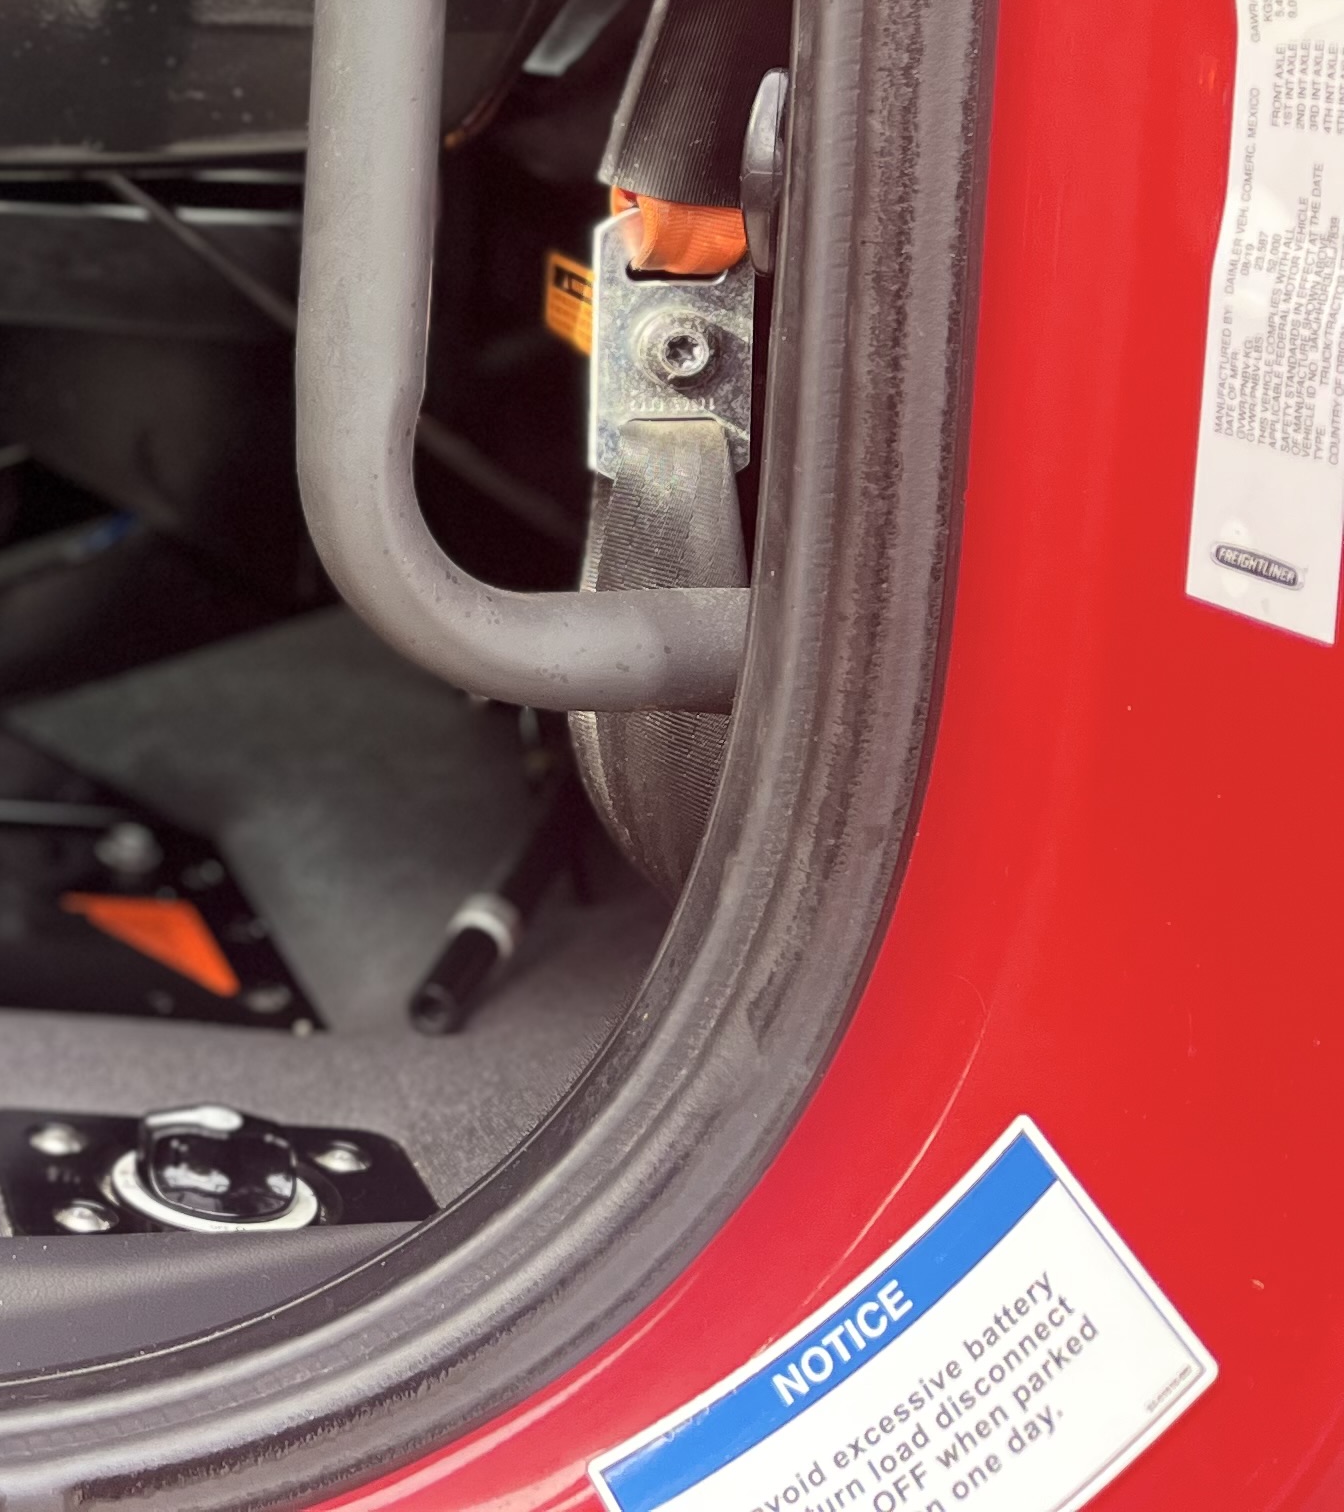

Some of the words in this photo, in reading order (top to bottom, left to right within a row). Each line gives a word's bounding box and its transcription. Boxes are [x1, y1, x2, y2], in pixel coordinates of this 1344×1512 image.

[1271, 83, 1283, 126] FRONT
[1284, 79, 1294, 100] INT
[1295, 79, 1307, 100] INT
[1311, 78, 1321, 101] INT
[1324, 82, 1335, 104] INT
[1283, 103, 1293, 126] 1ST
[1296, 103, 1307, 130] 2ND
[1309, 105, 1320, 131] 3RD
[1323, 106, 1333, 134] 4TH
[1310, 163, 1324, 198] DATE
[1291, 196, 1309, 251] VEHICLE
[1309, 202, 1322, 226] THE
[1283, 226, 1295, 248] ALL
[1308, 230, 1318, 246] AT
[1310, 233, 1329, 278] ABOVE
[1214, 328, 1232, 434] MANUFACTURED
[1224, 238, 1245, 294] DAIMLER
[1247, 87, 1260, 138] MEXICO
[1275, 252, 1290, 285] WITH
[1283, 256, 1301, 304] MOTOR
[1295, 249, 1317, 298] EFFECT
[1266, 287, 1283, 355] COMPLIES
[1293, 302, 1304, 315] IN
[1301, 281, 1322, 330] SHOWN
[1275, 308, 1291, 366] FEDERAL
[1284, 319, 1302, 398] STANDARDS
[1227, 383, 1238, 400] OF
[1260, 359, 1275, 412] VEHICLE
[1293, 334, 1310, 434] MANUFACTURE
[1306, 385, 1317, 399] ID
[1332, 378, 1344, 397] OF
[1225, 404, 1236, 437] DATE
[1268, 371, 1284, 450] APPLICABLE
[1280, 401, 1293, 453] SAFETY
[1301, 403, 1317, 458] VEHICLE
[1257, 418, 1269, 446] THIS
[1291, 439, 1302, 456] OF
[1328, 400, 1342, 466] COUNTRY
[1217, 547, 1295, 584] FREIGHTLINER
[770, 1278, 914, 1407] NOTICE
[832, 1359, 963, 1471] excessive
[963, 1270, 1053, 1362] battery
[867, 1426, 932, 1482] load
[935, 1293, 1075, 1430] disconnect
[873, 1460, 928, 1512] OFF
[936, 1404, 1010, 1470] when
[1012, 1313, 1100, 1414] parked
[951, 1450, 1004, 1502] one
[1008, 1404, 1064, 1455] day.
